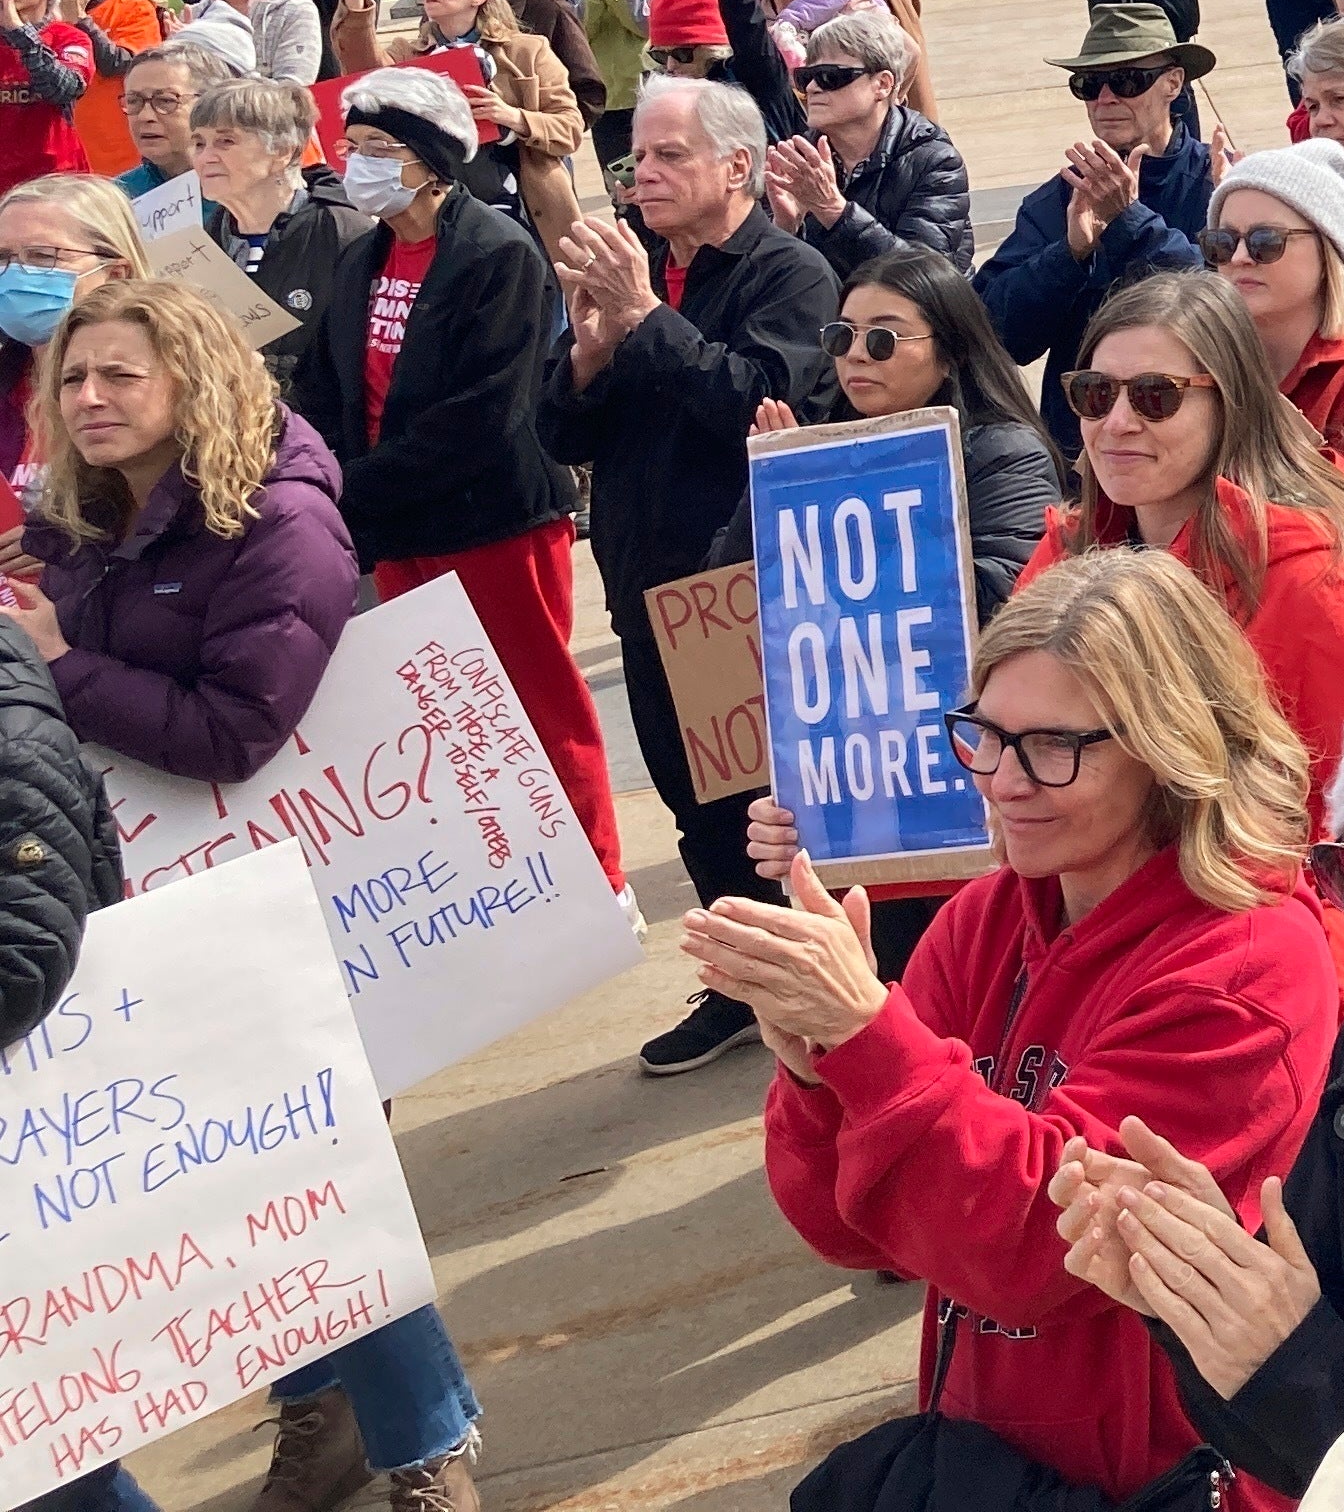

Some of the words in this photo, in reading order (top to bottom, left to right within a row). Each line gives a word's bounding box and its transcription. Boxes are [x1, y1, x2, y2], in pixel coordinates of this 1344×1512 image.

[777, 488, 923, 609] NOT
[396, 660, 452, 741] DANGER
[415, 640, 462, 701] FROM
[453, 700, 493, 762] THOSE
[787, 606, 941, 726] ONE
[450, 647, 536, 766] CONFISCATE
[517, 768, 567, 839] GUNS
[798, 724, 966, 806] MORE.
[332, 849, 458, 933] MORE
[33, 1152, 126, 1229] NOT
[143, 1067, 341, 1193] ENOUGH!
[246, 1180, 347, 1248] MOM
[49, 1416, 124, 1478] HAS
[133, 1379, 209, 1434] HAD
[235, 1268, 391, 1388] ENOUGH!
[152, 1258, 367, 1368] TEACHER
